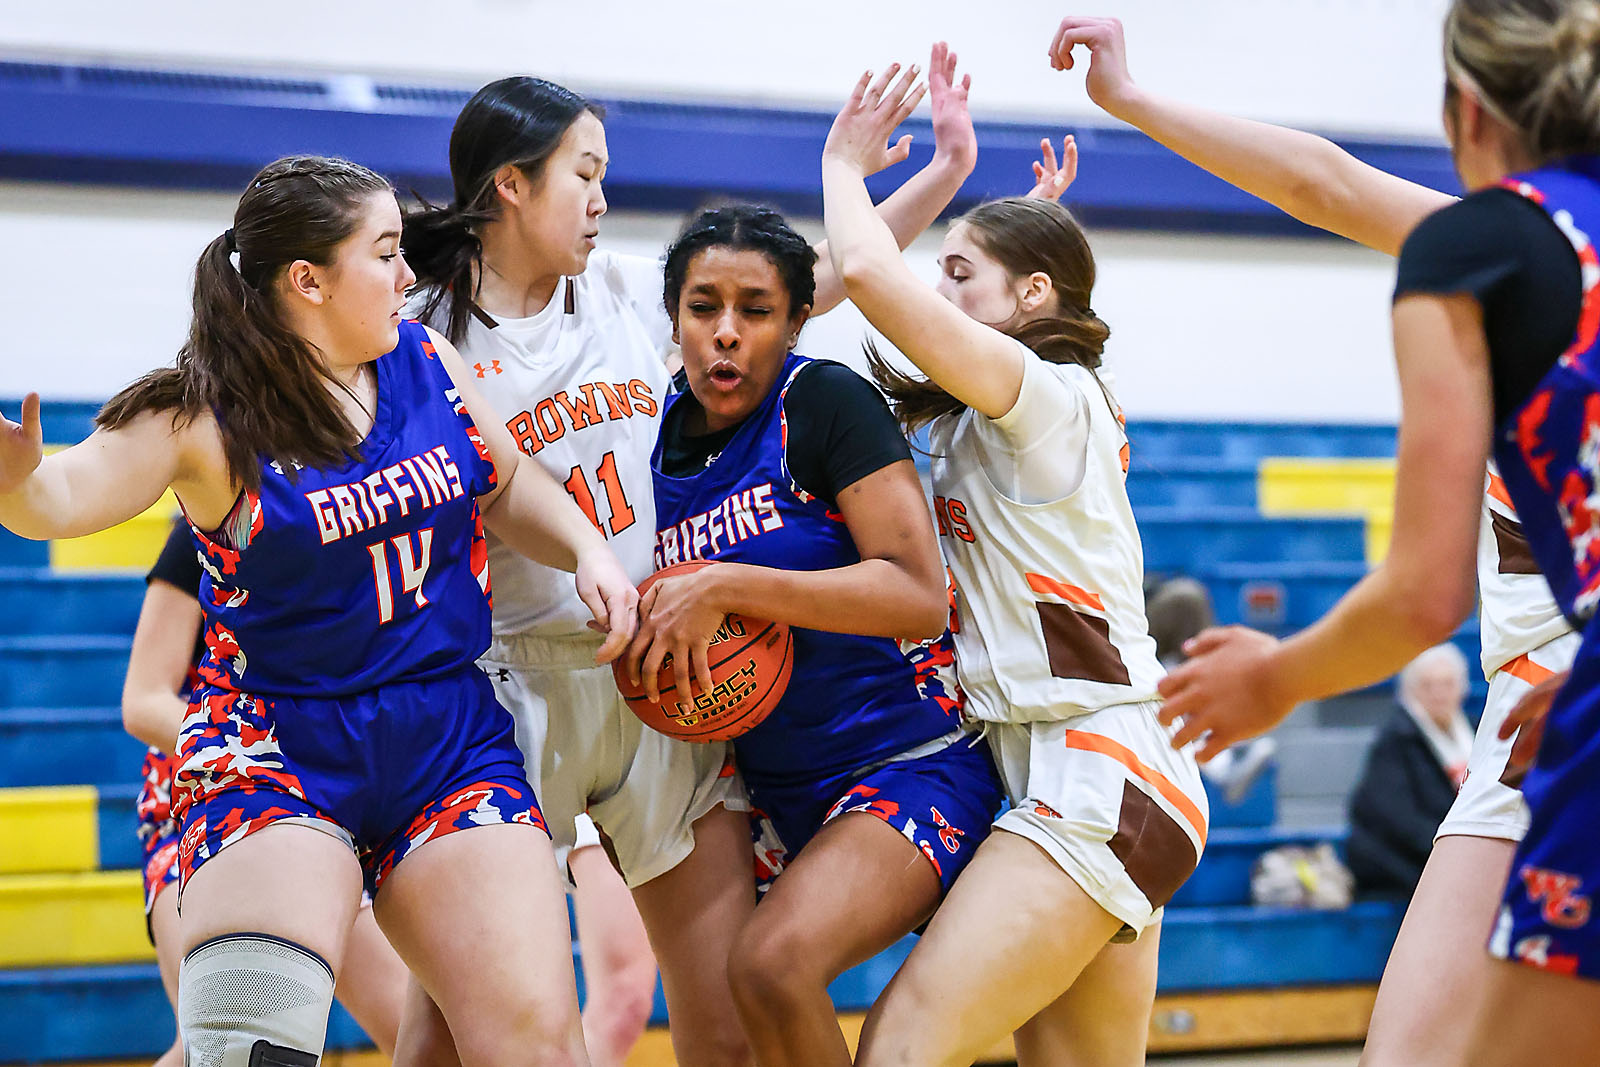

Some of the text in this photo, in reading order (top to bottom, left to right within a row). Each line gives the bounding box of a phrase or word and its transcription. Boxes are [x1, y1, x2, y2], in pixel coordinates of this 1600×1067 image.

[505, 379, 658, 457] ROWNS
[304, 445, 465, 546] GRIFFINS
[563, 451, 636, 541] 11
[366, 527, 434, 625] 14
[700, 681, 758, 721] 1000
